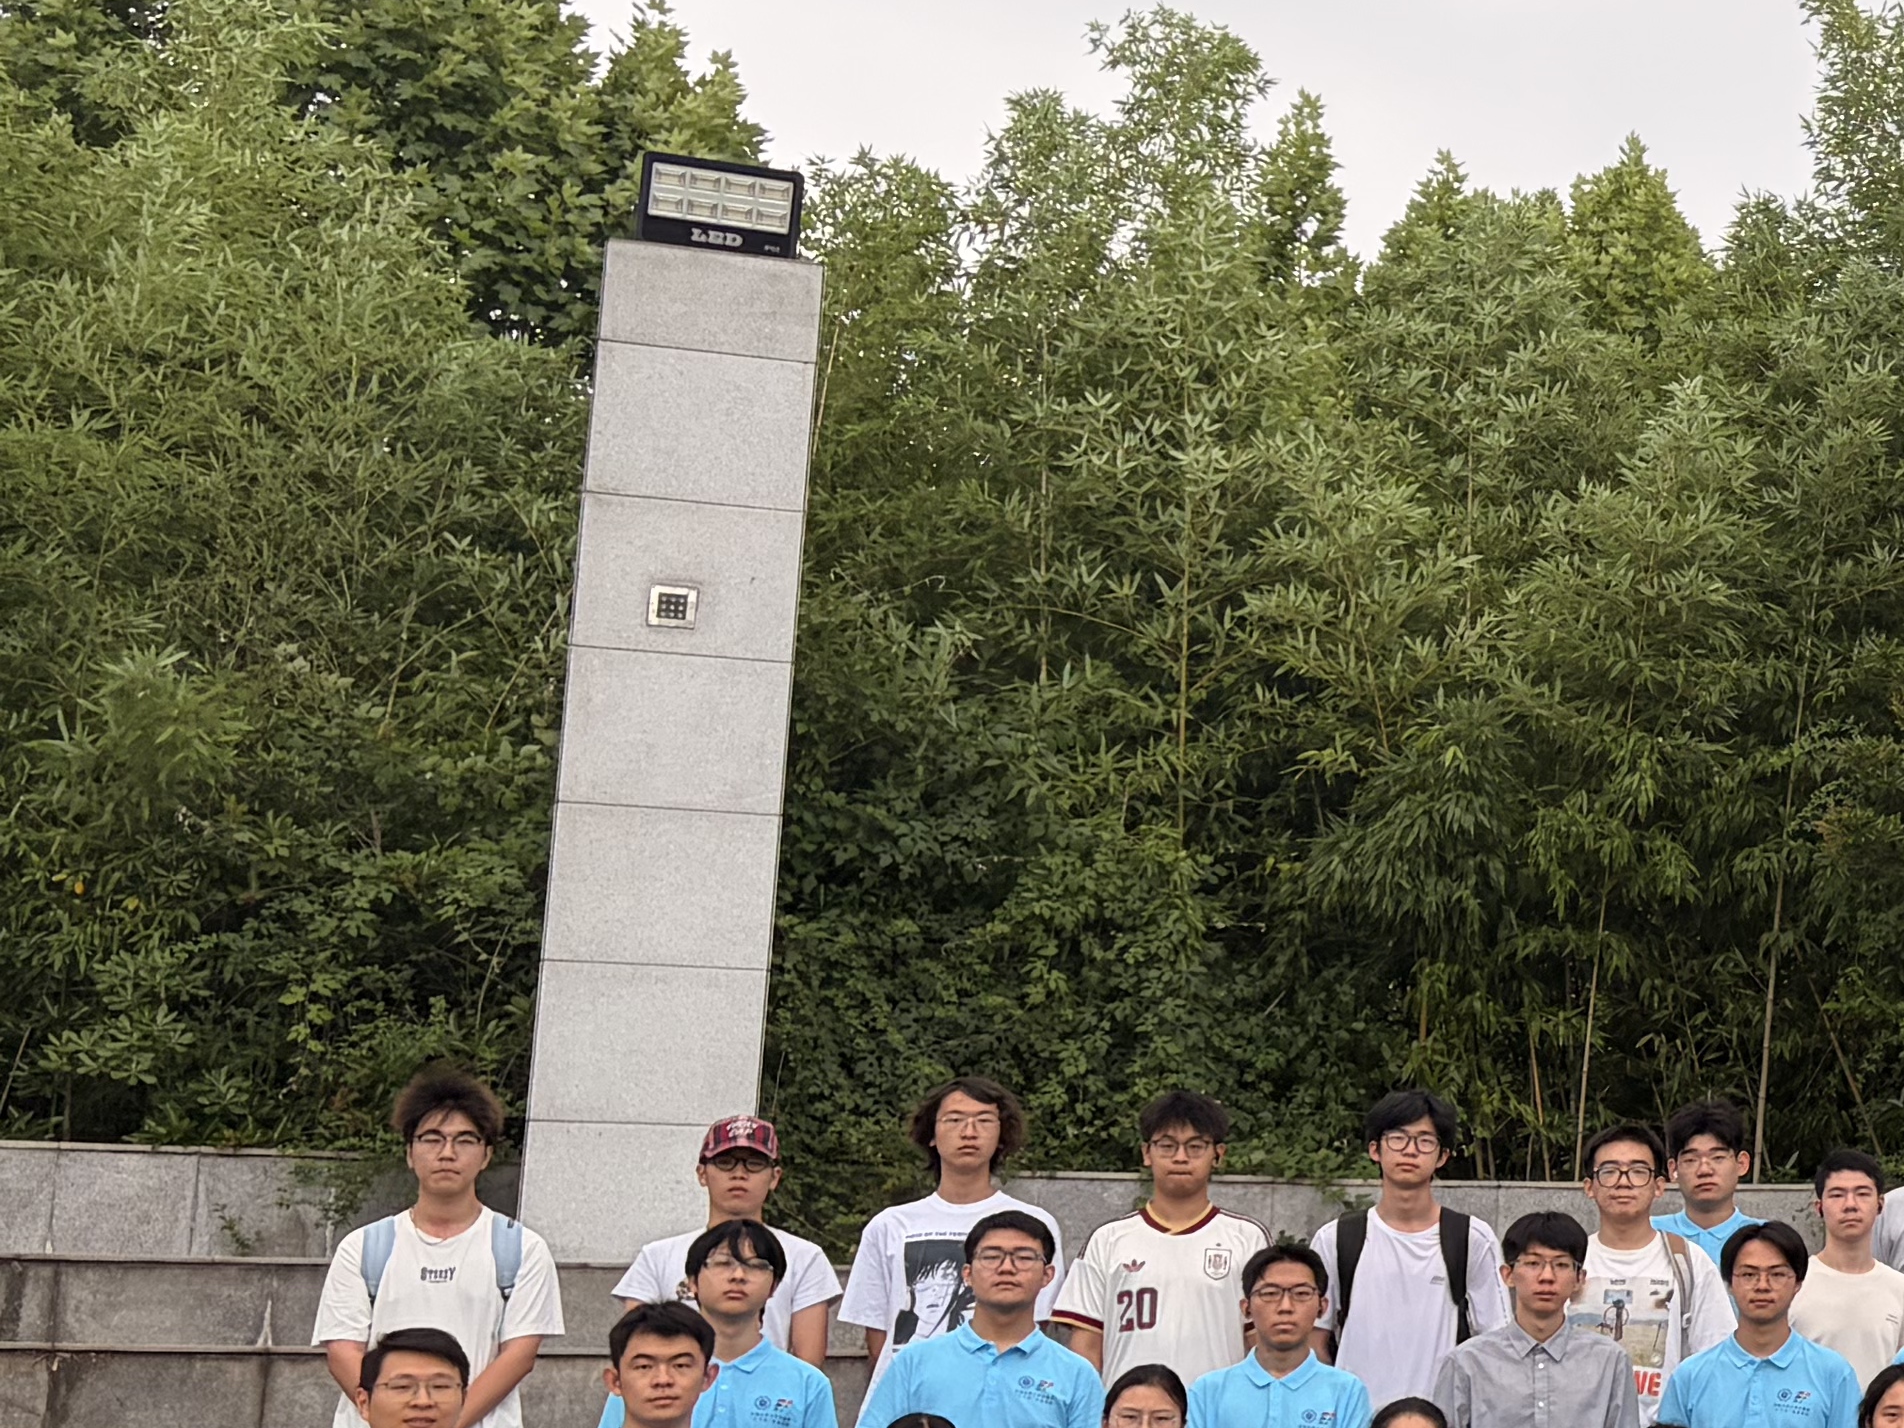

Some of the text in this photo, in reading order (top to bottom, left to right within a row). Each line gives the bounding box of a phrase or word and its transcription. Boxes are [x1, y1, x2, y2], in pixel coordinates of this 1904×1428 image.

[691, 228, 743, 247] LED
[1117, 1287, 1158, 1332] 20
[1635, 1370, 1662, 1397] VE
